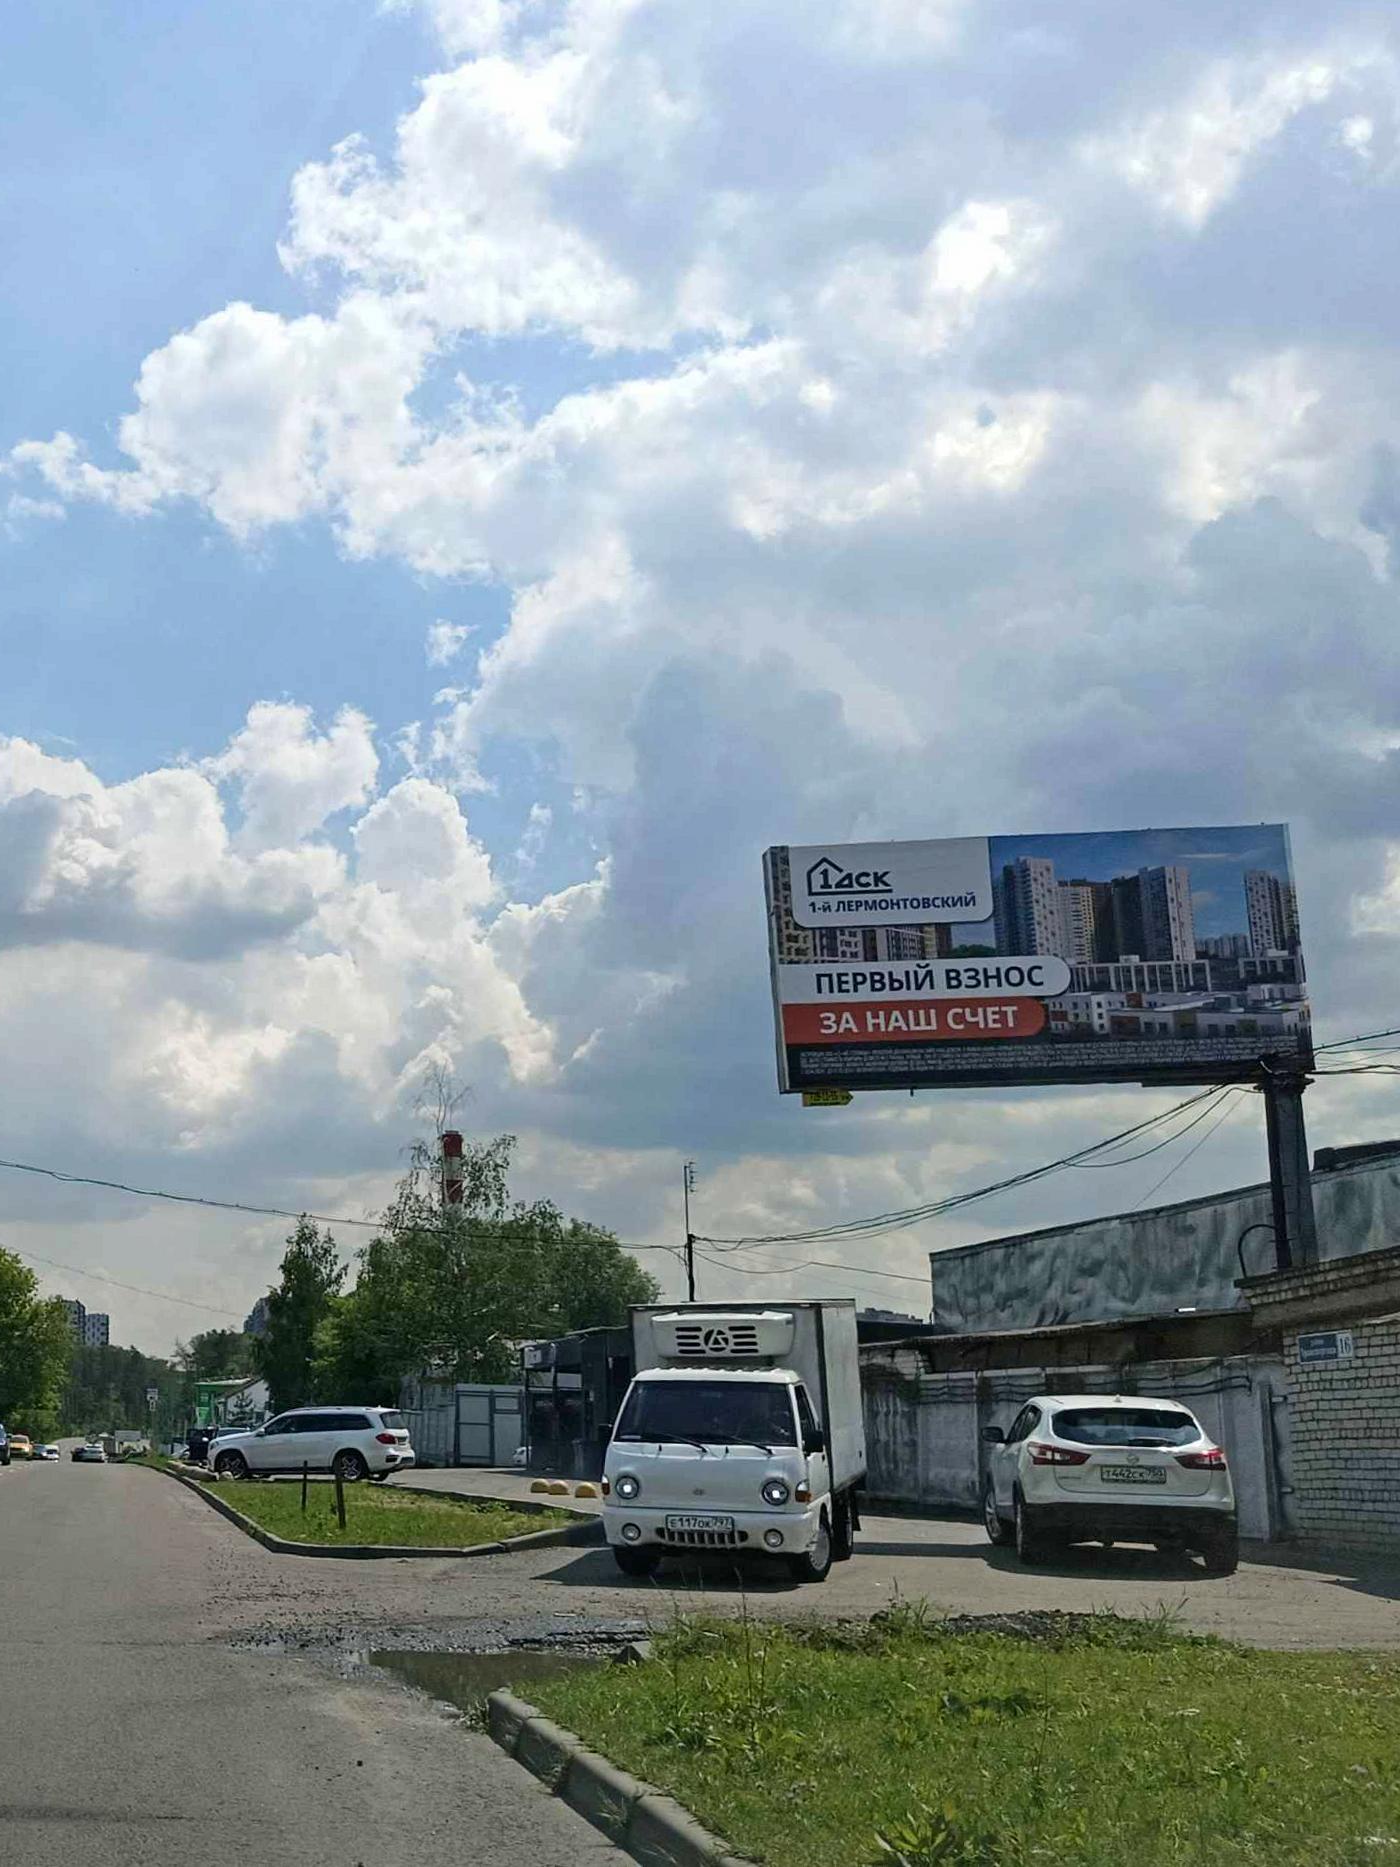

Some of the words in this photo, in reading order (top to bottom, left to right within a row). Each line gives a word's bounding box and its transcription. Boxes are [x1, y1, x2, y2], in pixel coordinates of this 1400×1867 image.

[819, 868, 892, 890] 1ДСК
[808, 901, 832, 913] 1-й
[834, 891, 977, 913] ЛЕРМОНТОВСКИЙ
[815, 963, 935, 995] ПЕРВЫЙ
[945, 965, 1045, 991] ВЗНОС
[819, 1011, 858, 1035] ЗА
[865, 1007, 938, 1034] НАШ
[946, 1005, 1019, 1030] СЧЕТ
[1340, 1336, 1352, 1354] 16
